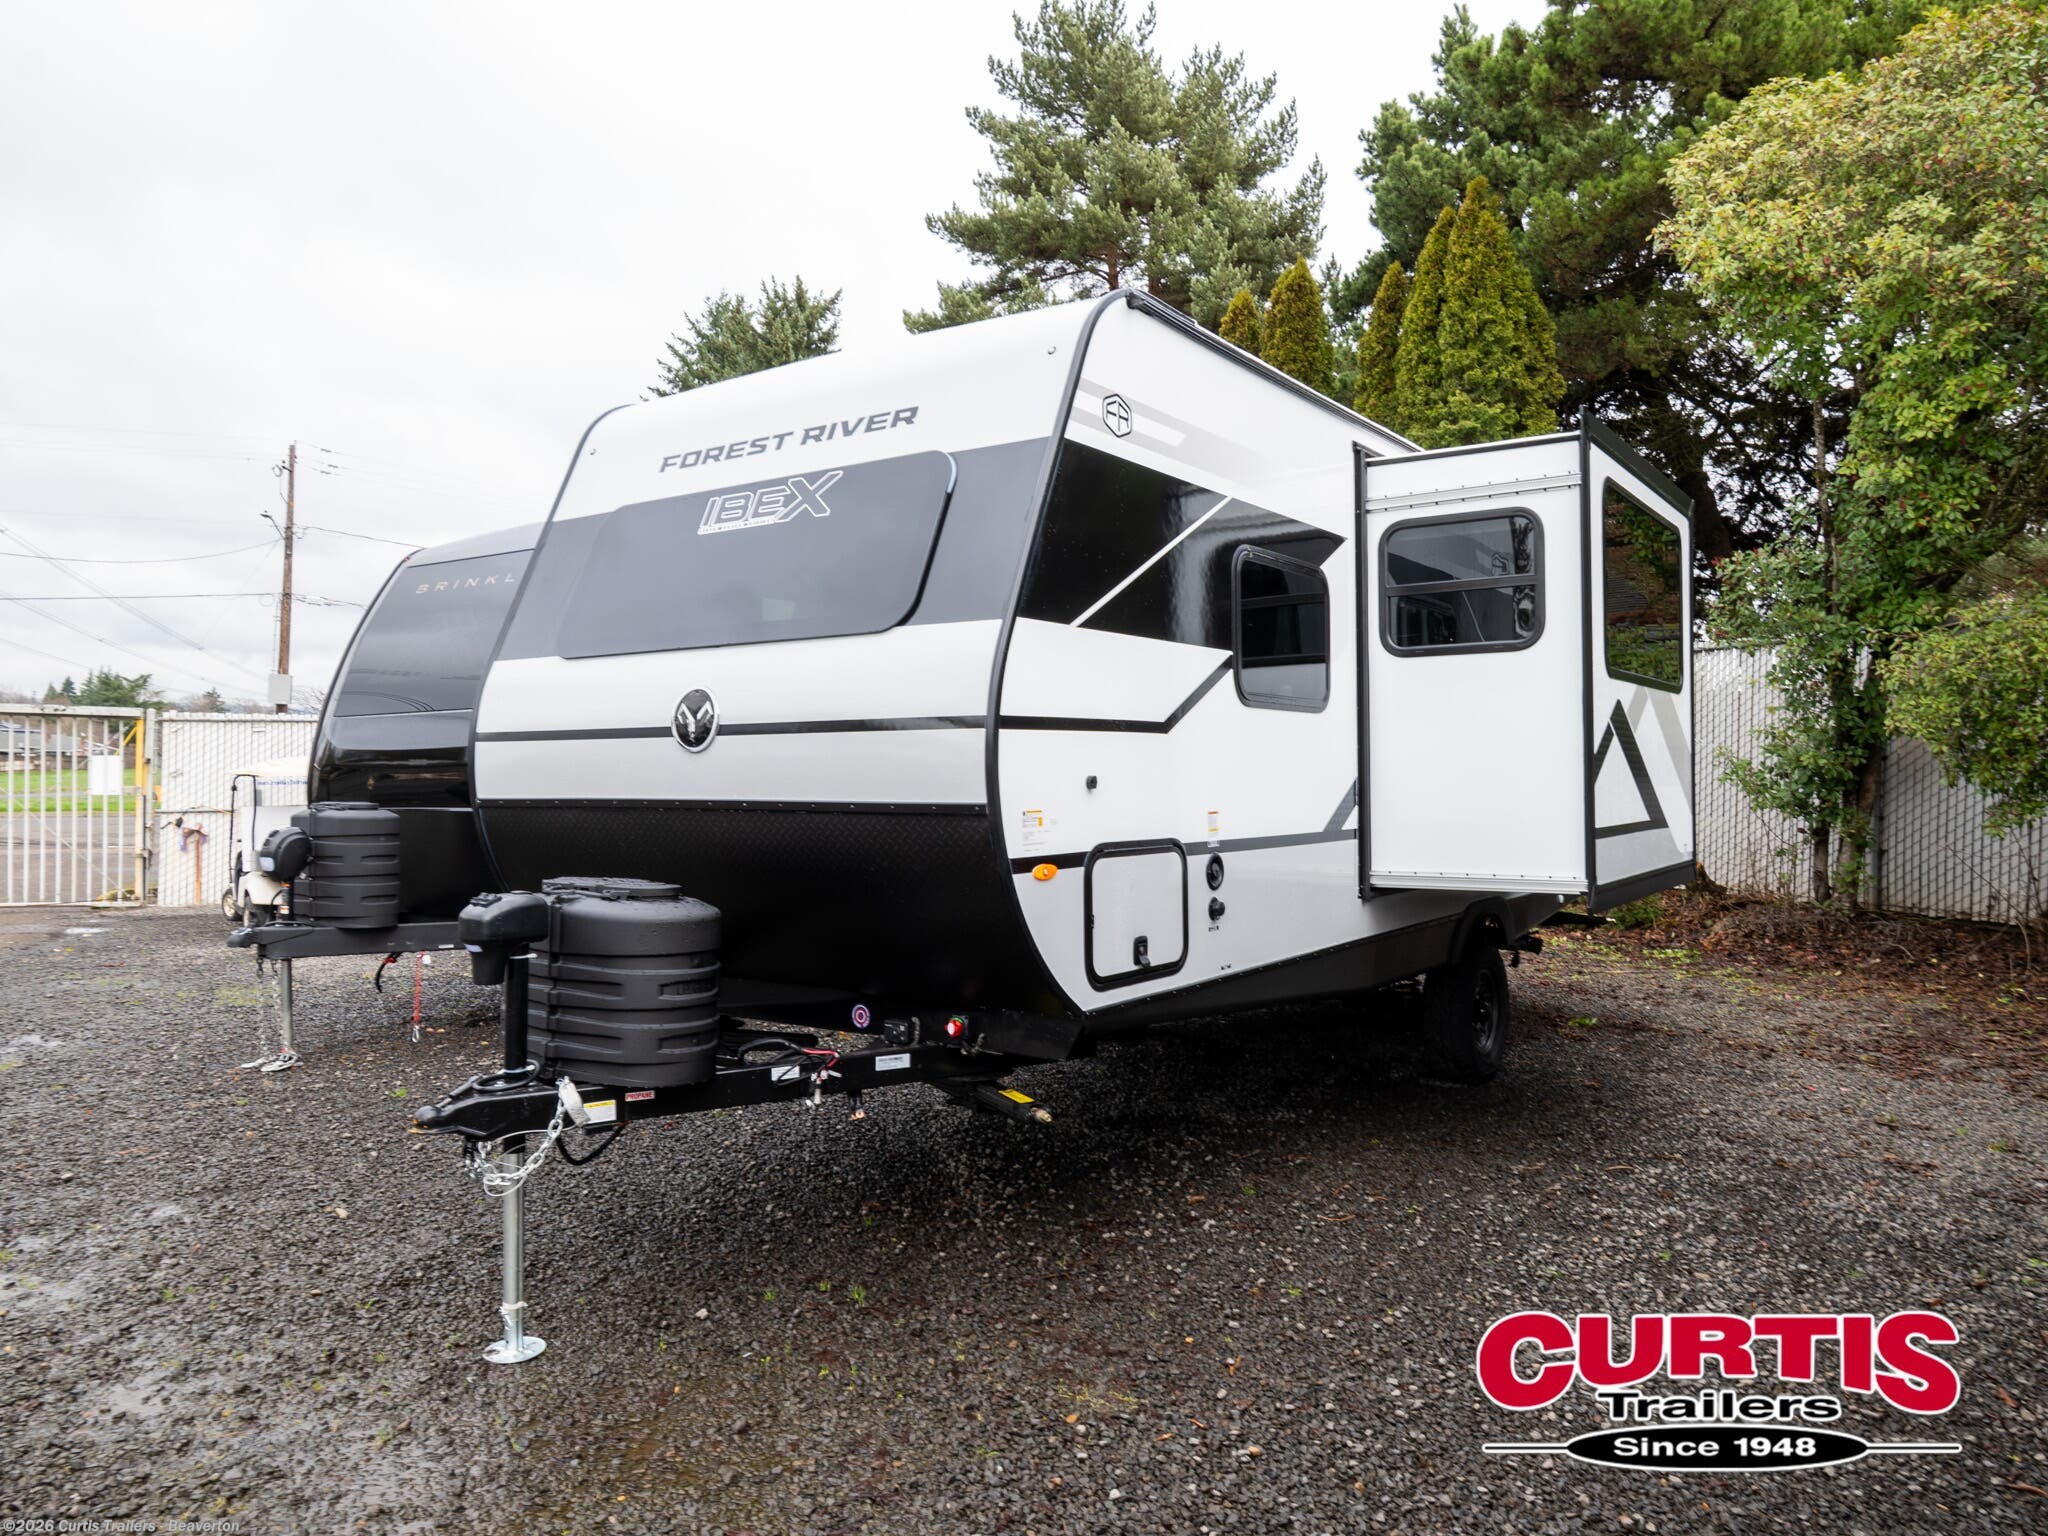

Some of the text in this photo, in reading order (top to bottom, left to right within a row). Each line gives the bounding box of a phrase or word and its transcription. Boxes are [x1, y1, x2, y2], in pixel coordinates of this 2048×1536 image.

[659, 406, 919, 473] FOREST RIVER
[699, 470, 844, 529] IBEX
[626, 1091, 653, 1100] PROPANE
